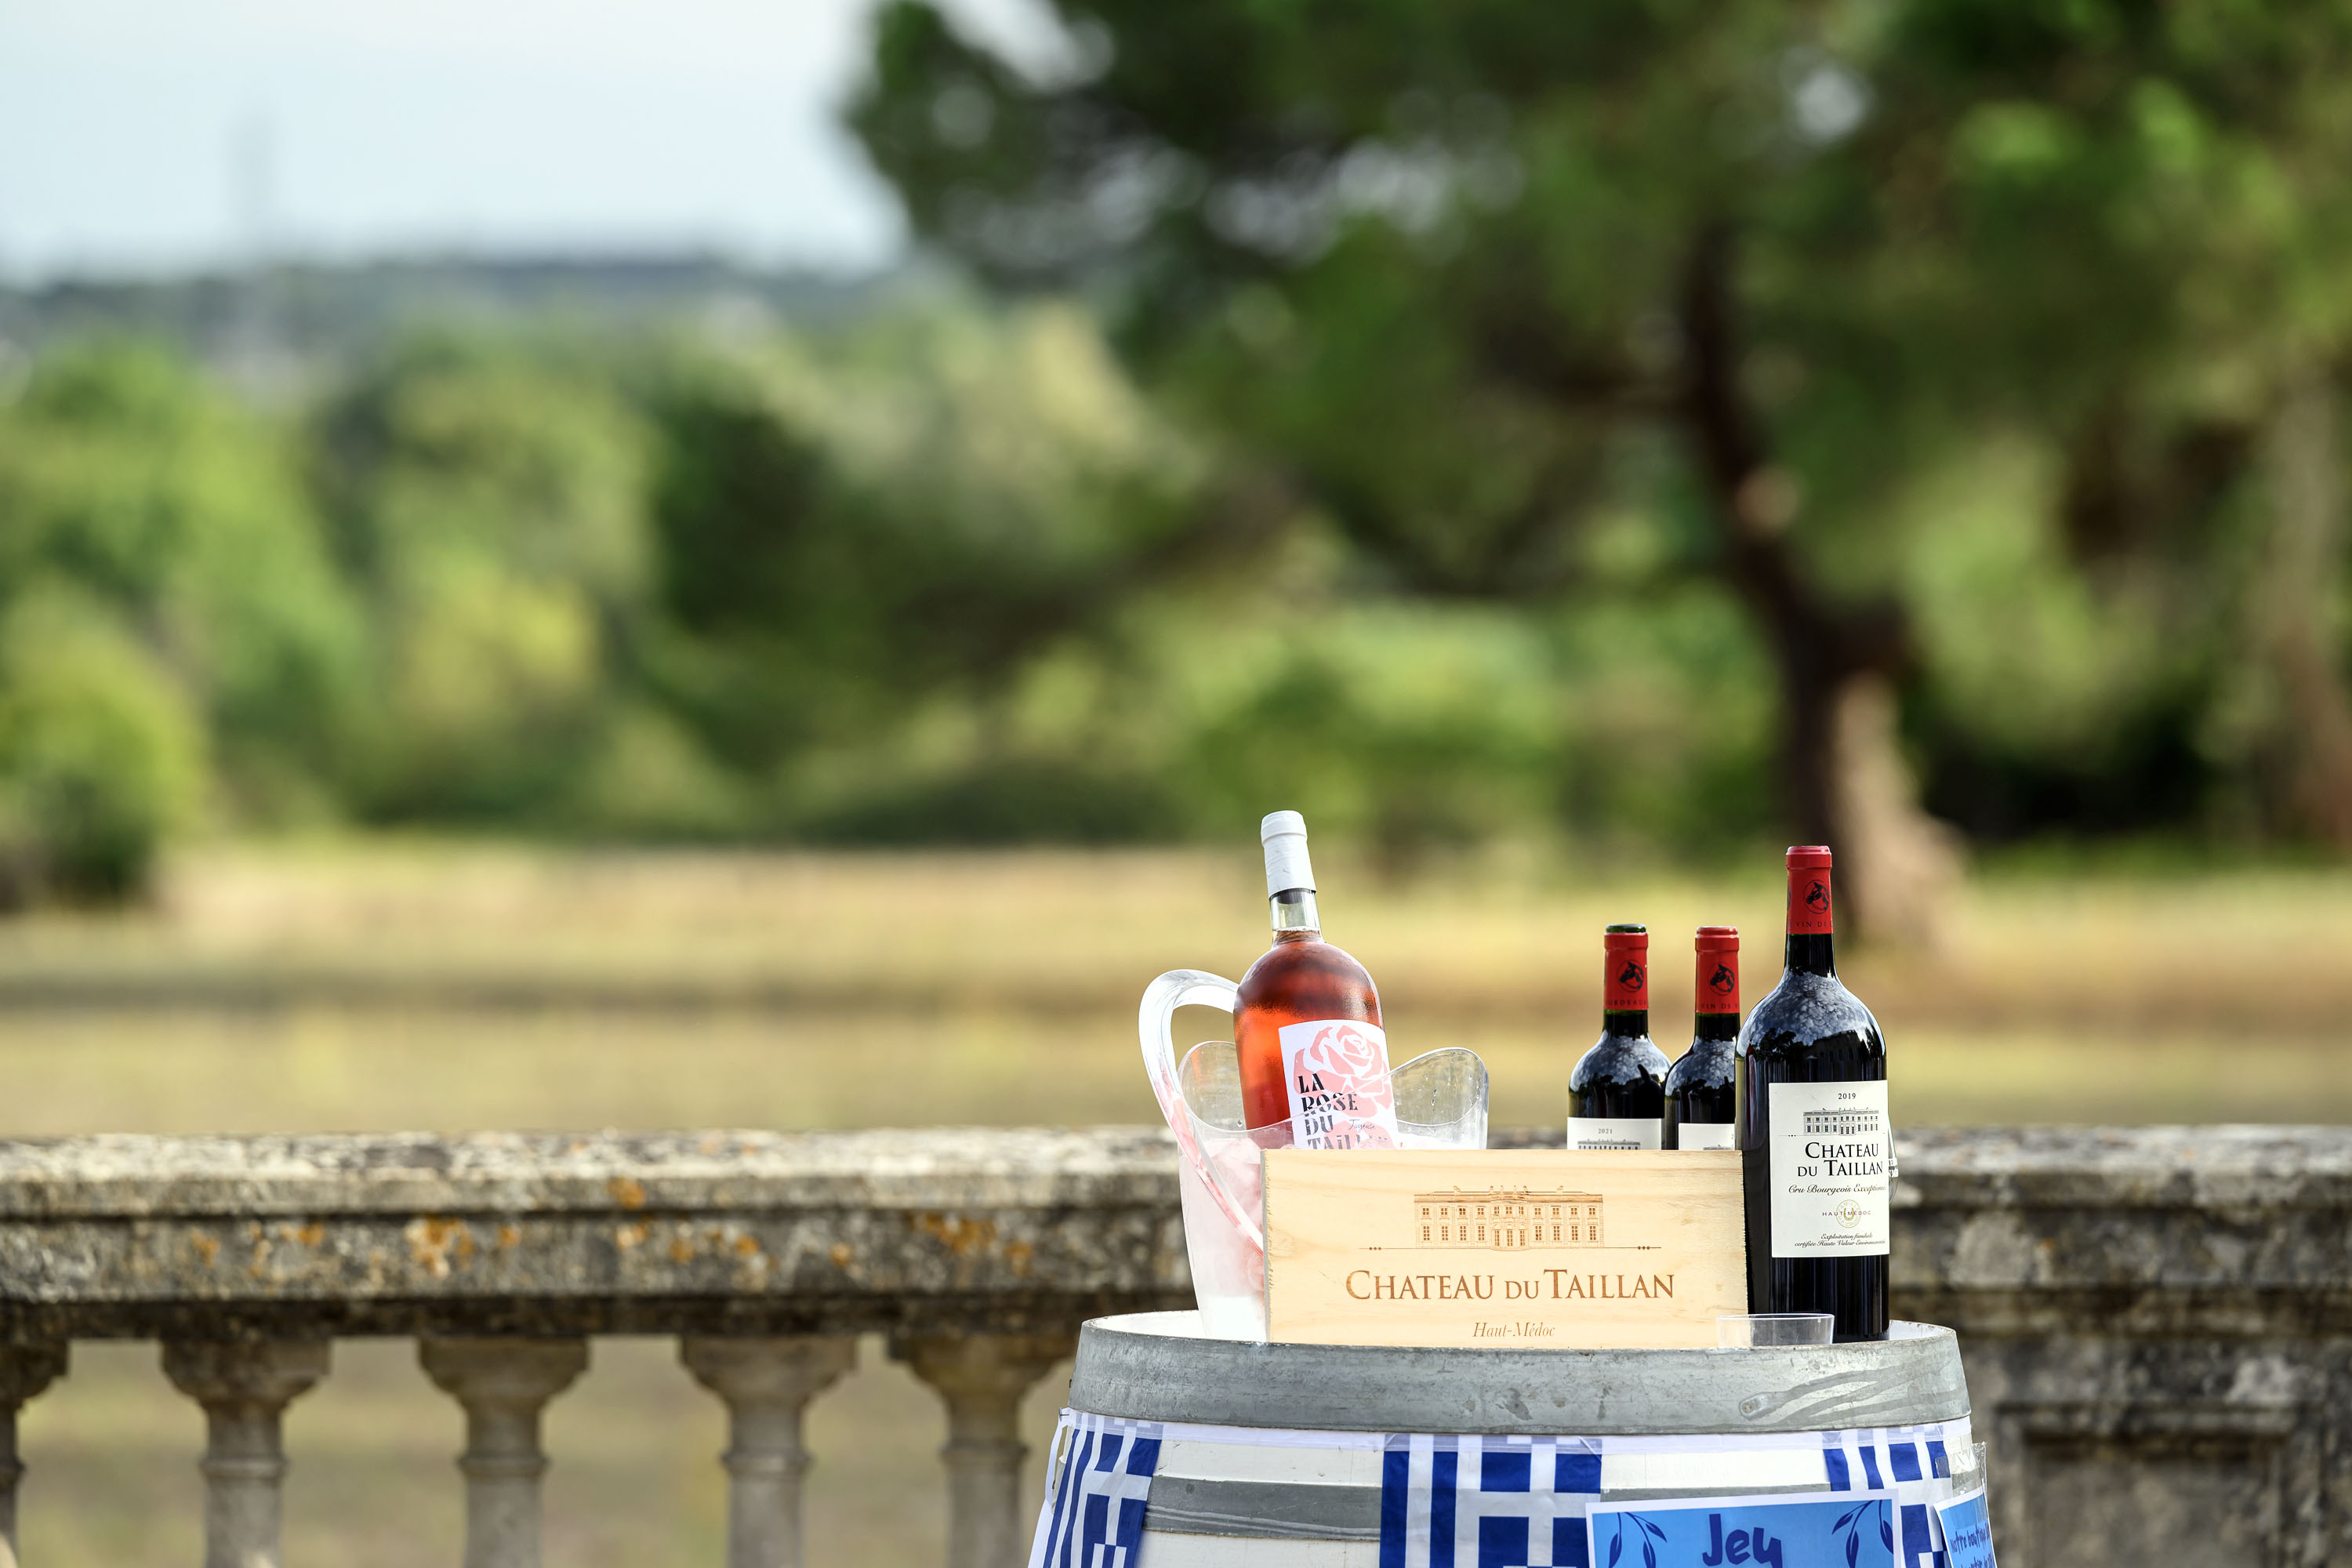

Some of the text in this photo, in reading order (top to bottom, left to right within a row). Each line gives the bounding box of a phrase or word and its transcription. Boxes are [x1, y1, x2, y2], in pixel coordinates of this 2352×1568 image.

[1298, 1073, 1325, 1094] LA
[1301, 1091, 1359, 1116] ROSE
[1304, 1115, 1334, 1136] DU
[1805, 1142, 1878, 1159] CHATEAU
[1797, 1166, 1817, 1177] DU
[1824, 1160, 1883, 1176] TAILLAN
[1788, 1184, 1804, 1194] Cru
[1805, 1185, 1851, 1196] Bourgeois
[1345, 1269, 1675, 1300] CHATEAU DU TAILLAN
[1472, 1322, 1555, 1338] Haut-Médoc
